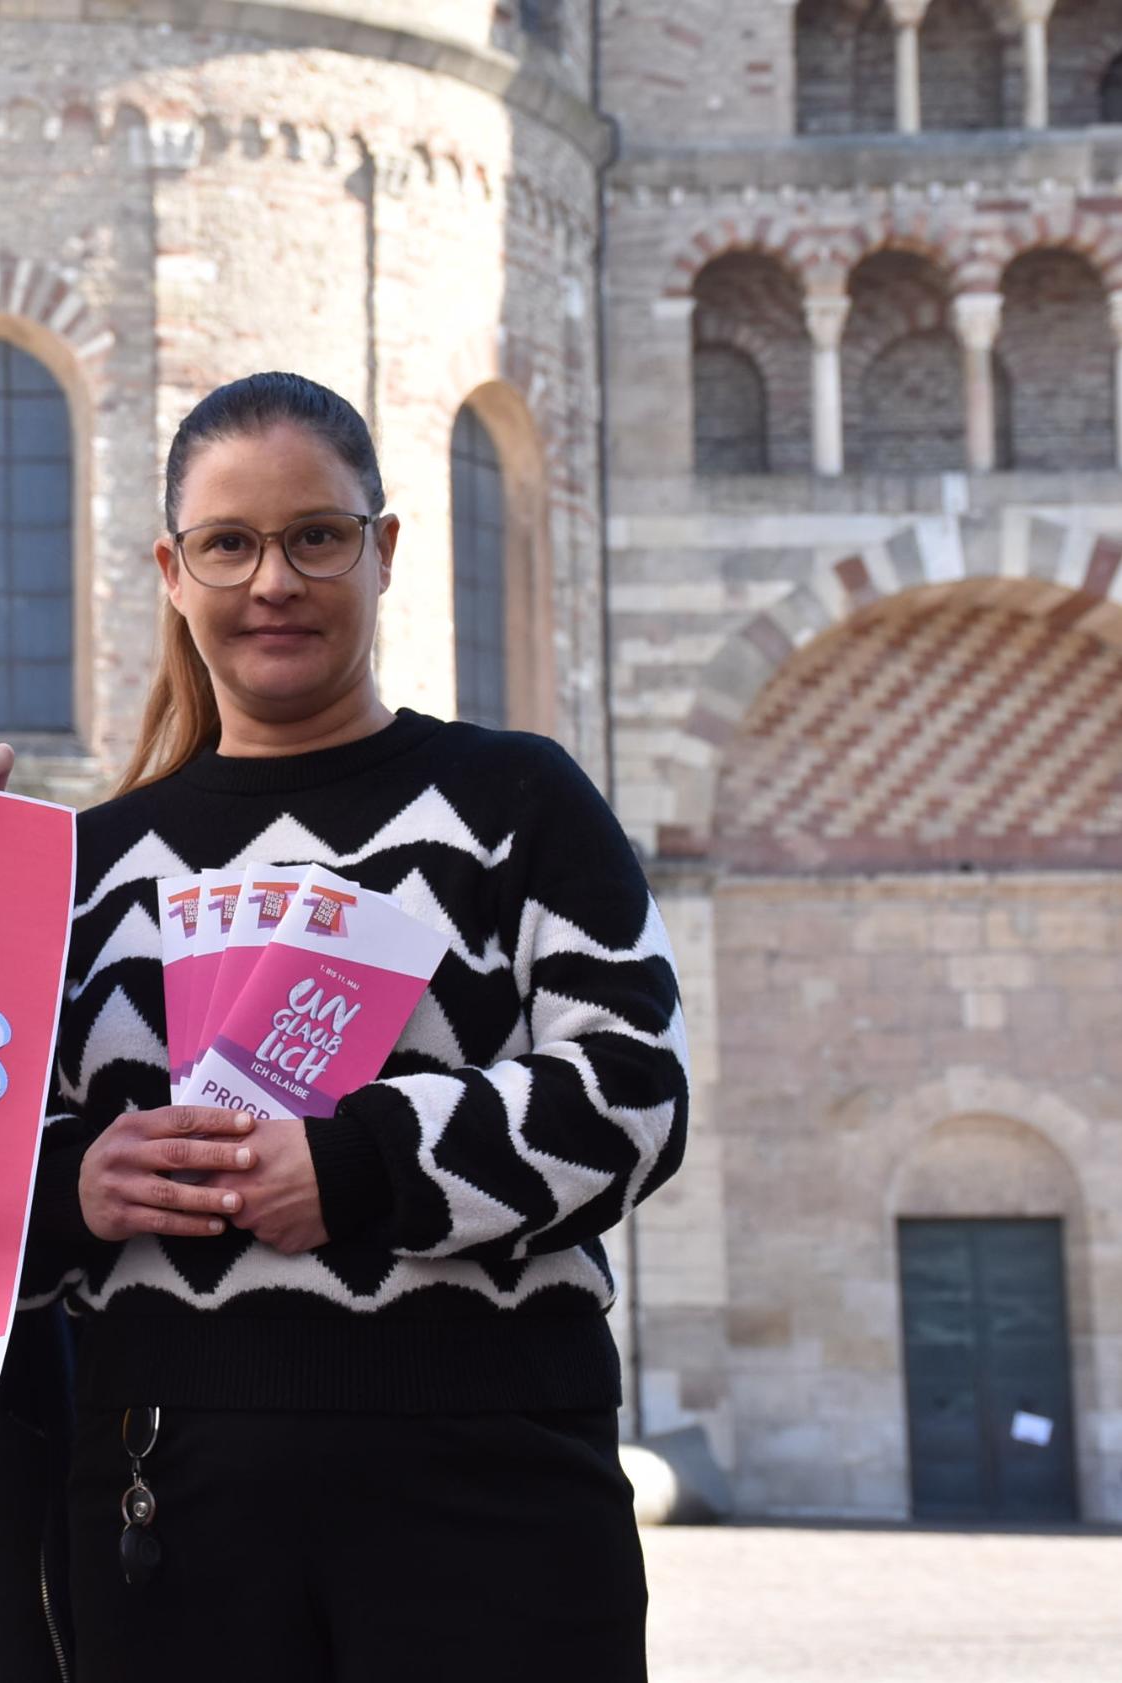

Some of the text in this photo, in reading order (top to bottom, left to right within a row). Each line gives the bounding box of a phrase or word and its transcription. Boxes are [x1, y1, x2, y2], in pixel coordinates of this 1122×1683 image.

[288, 977, 362, 1034] UN
[272, 1008, 343, 1056] GLAUB
[250, 1061, 310, 1100] ICH GLAUBE
